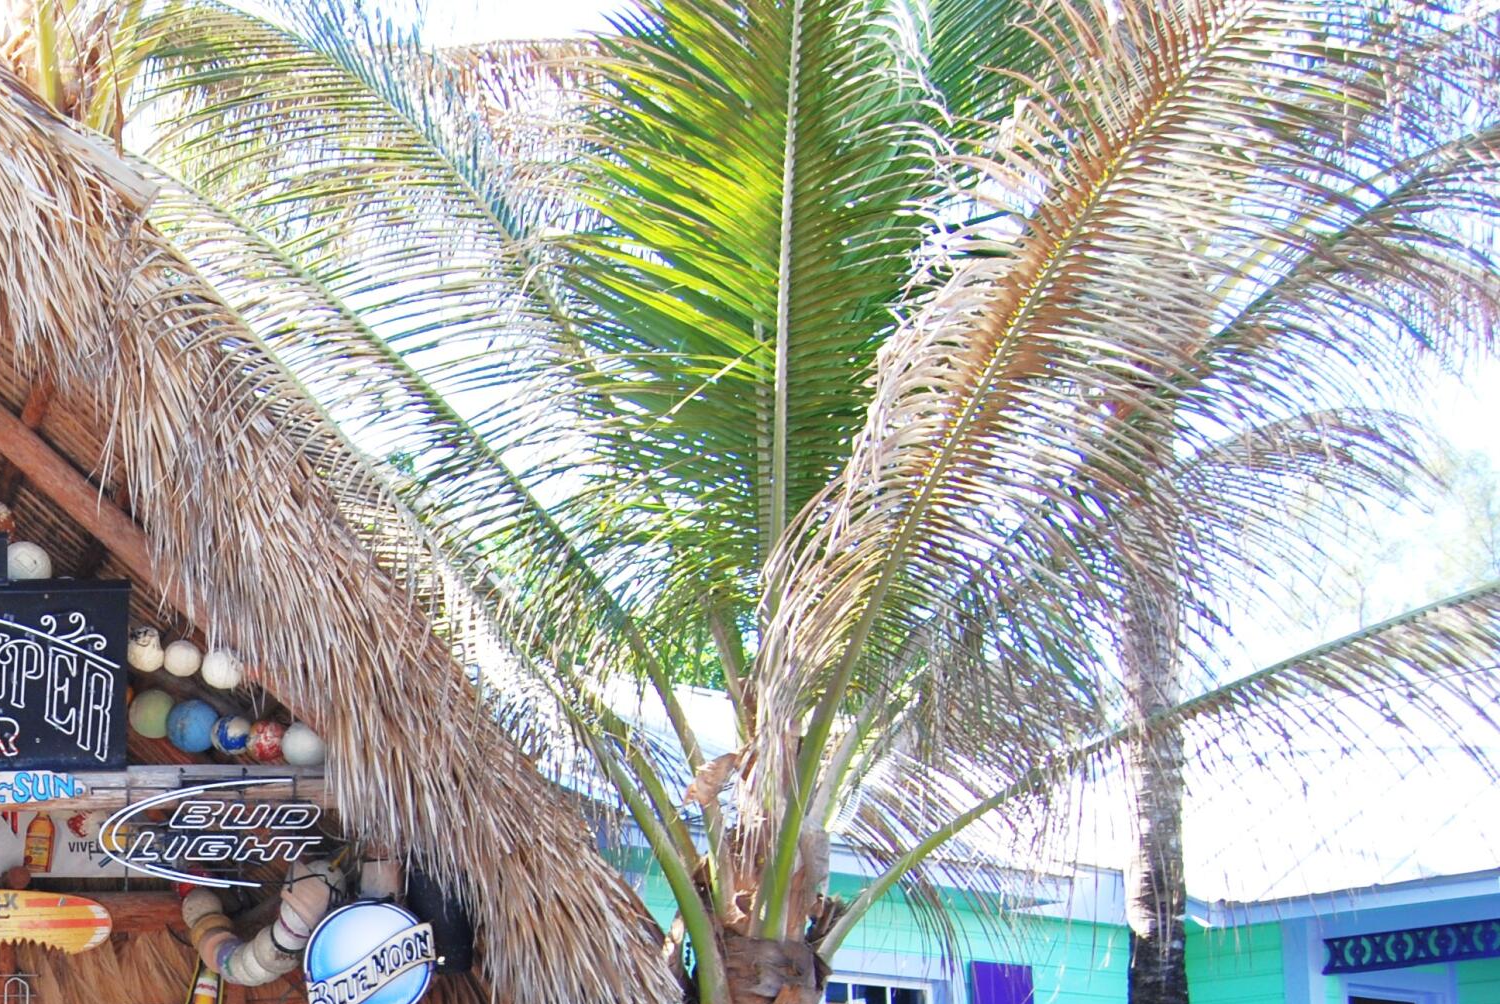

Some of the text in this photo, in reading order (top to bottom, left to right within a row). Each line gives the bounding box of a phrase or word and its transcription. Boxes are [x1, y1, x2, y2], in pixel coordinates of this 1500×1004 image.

[169, 800, 321, 829] BUD
[126, 831, 324, 862] LIGHT
[371, 929, 432, 987] MOON
